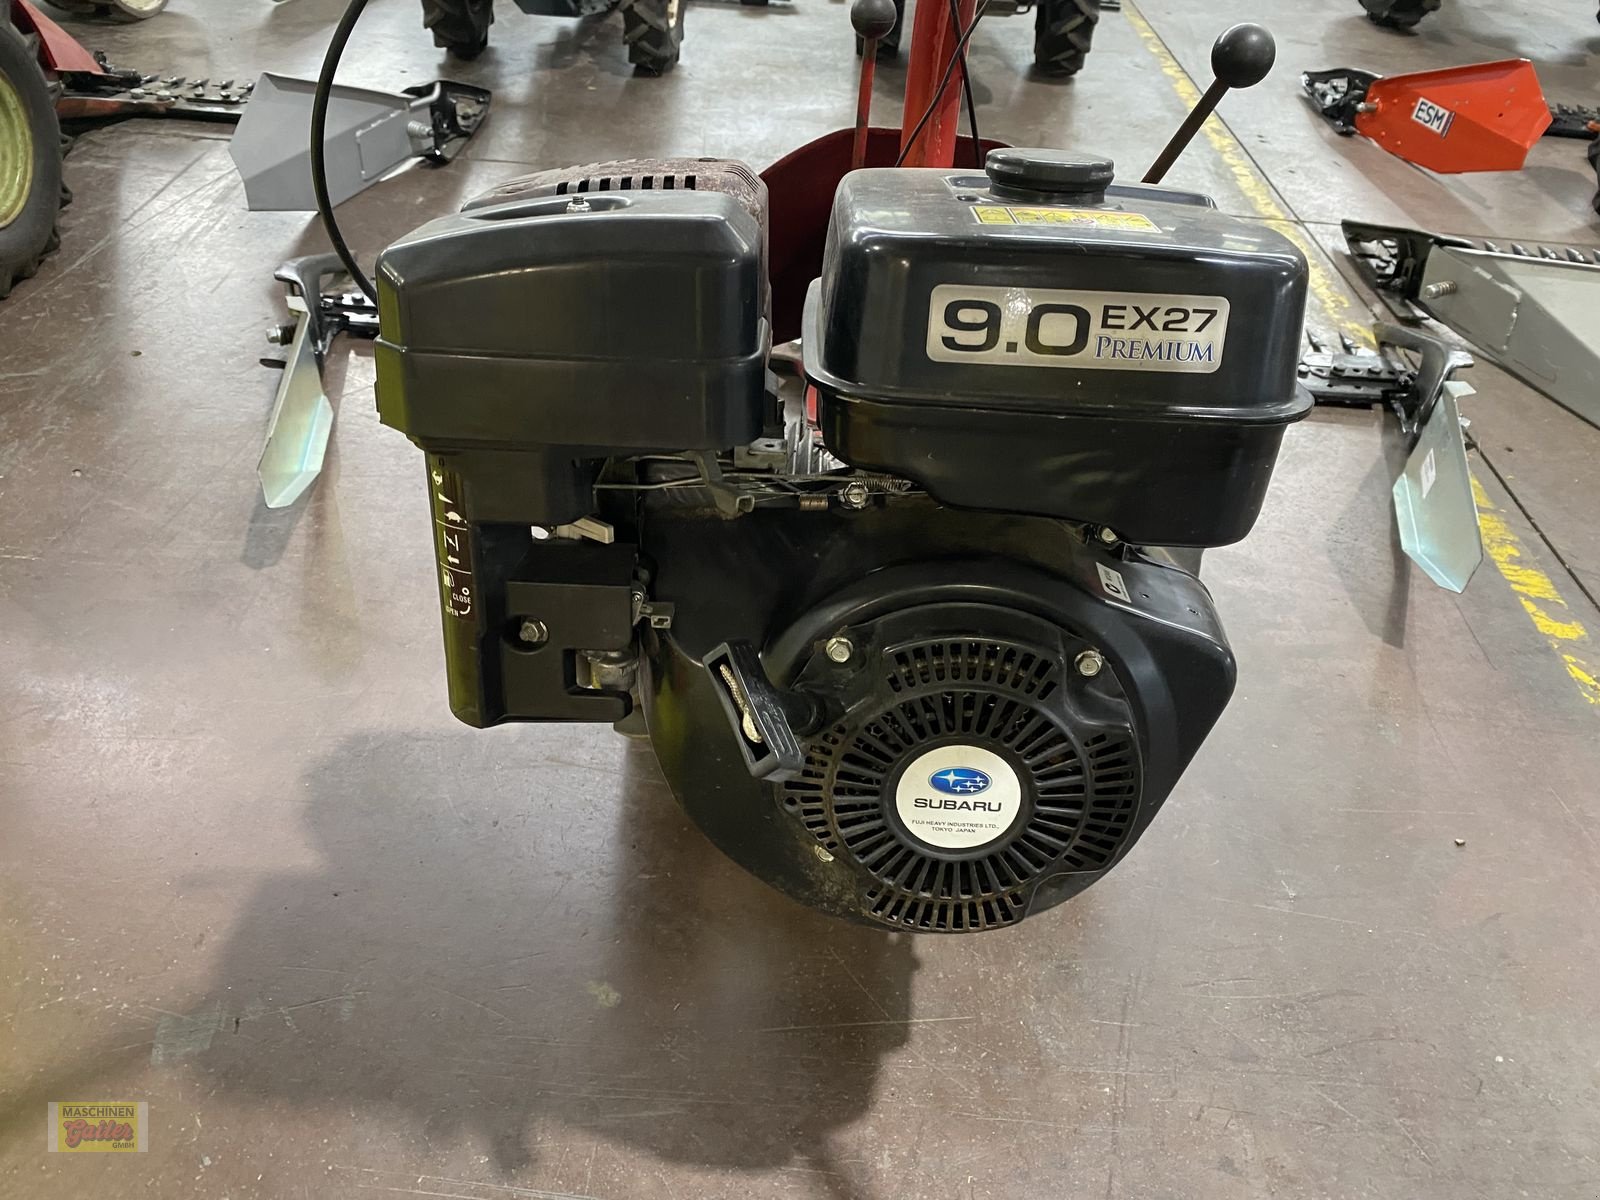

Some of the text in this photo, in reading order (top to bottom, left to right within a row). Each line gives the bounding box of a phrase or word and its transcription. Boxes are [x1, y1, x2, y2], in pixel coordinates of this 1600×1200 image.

[1414, 100, 1447, 131] ESM
[941, 299, 1092, 357] 9.0
[1100, 304, 1219, 334] EX27
[452, 592, 472, 605] CLOSE
[913, 797, 1003, 813] SUBARU
[946, 821, 984, 829] INDUSTRIES
